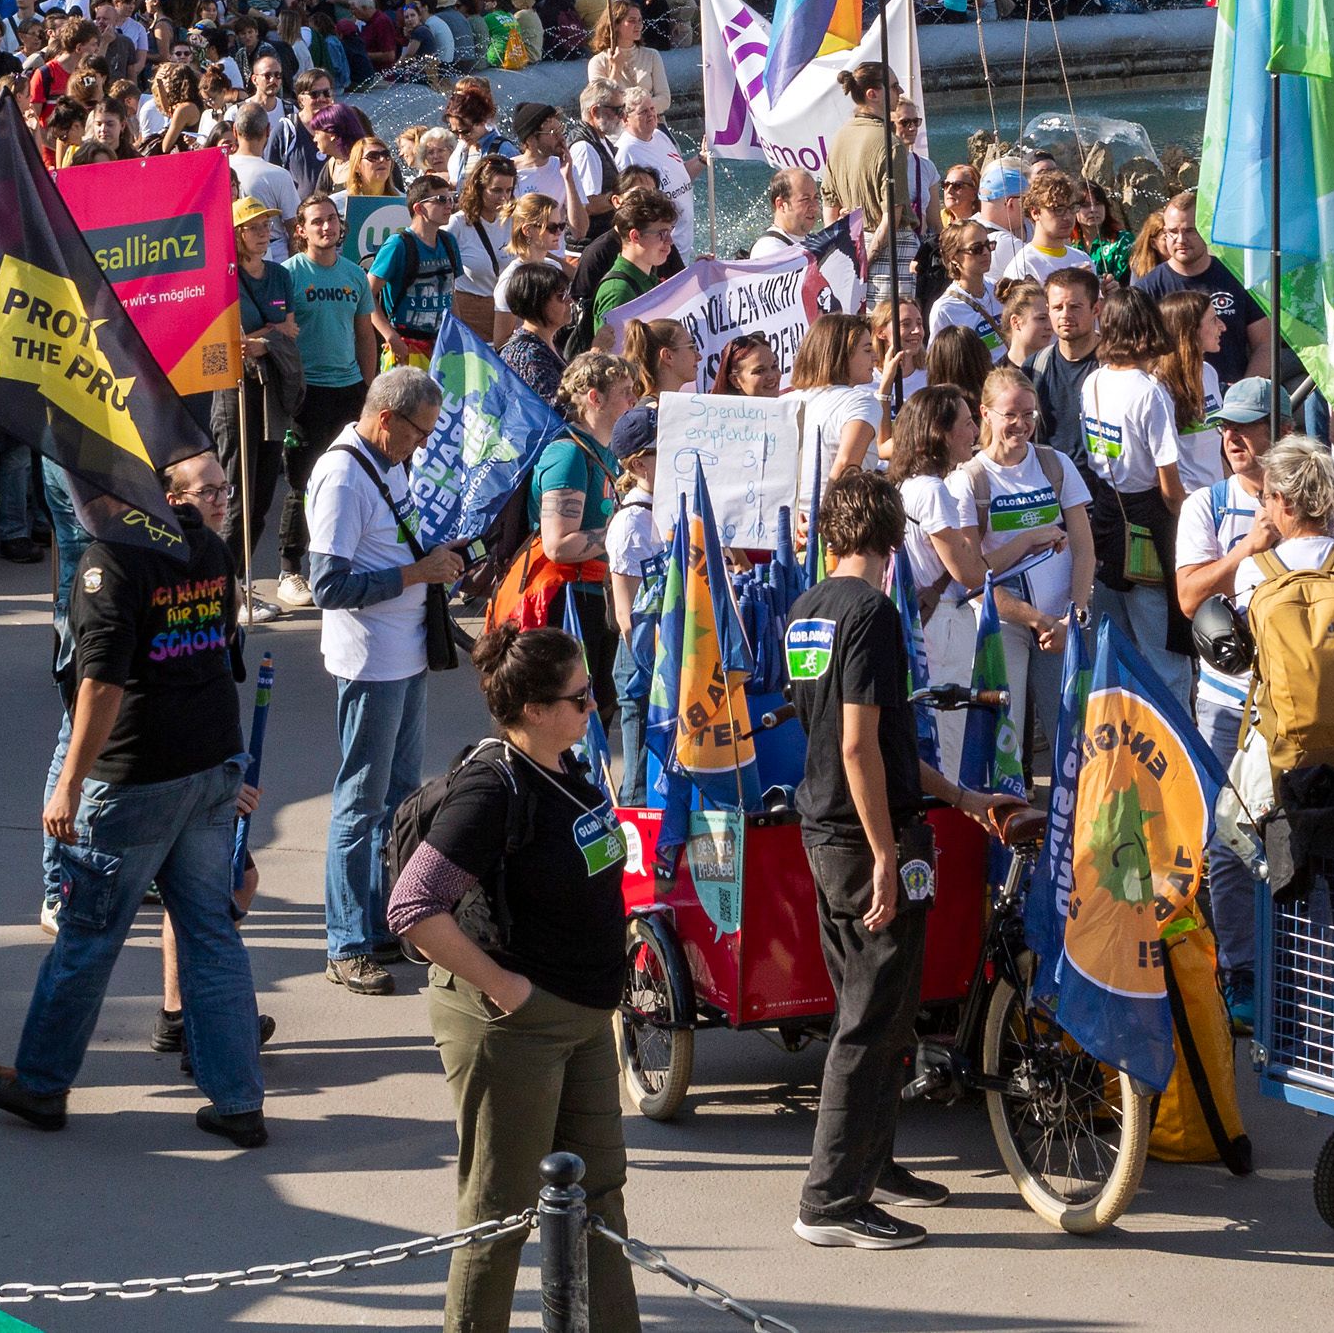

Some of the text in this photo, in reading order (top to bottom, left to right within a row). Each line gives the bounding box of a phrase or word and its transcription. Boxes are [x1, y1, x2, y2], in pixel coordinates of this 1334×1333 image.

[129, 285, 206, 307] wir's möglich!
[12, 336, 63, 365] THE
[996, 494, 1034, 508] GLOBAL
